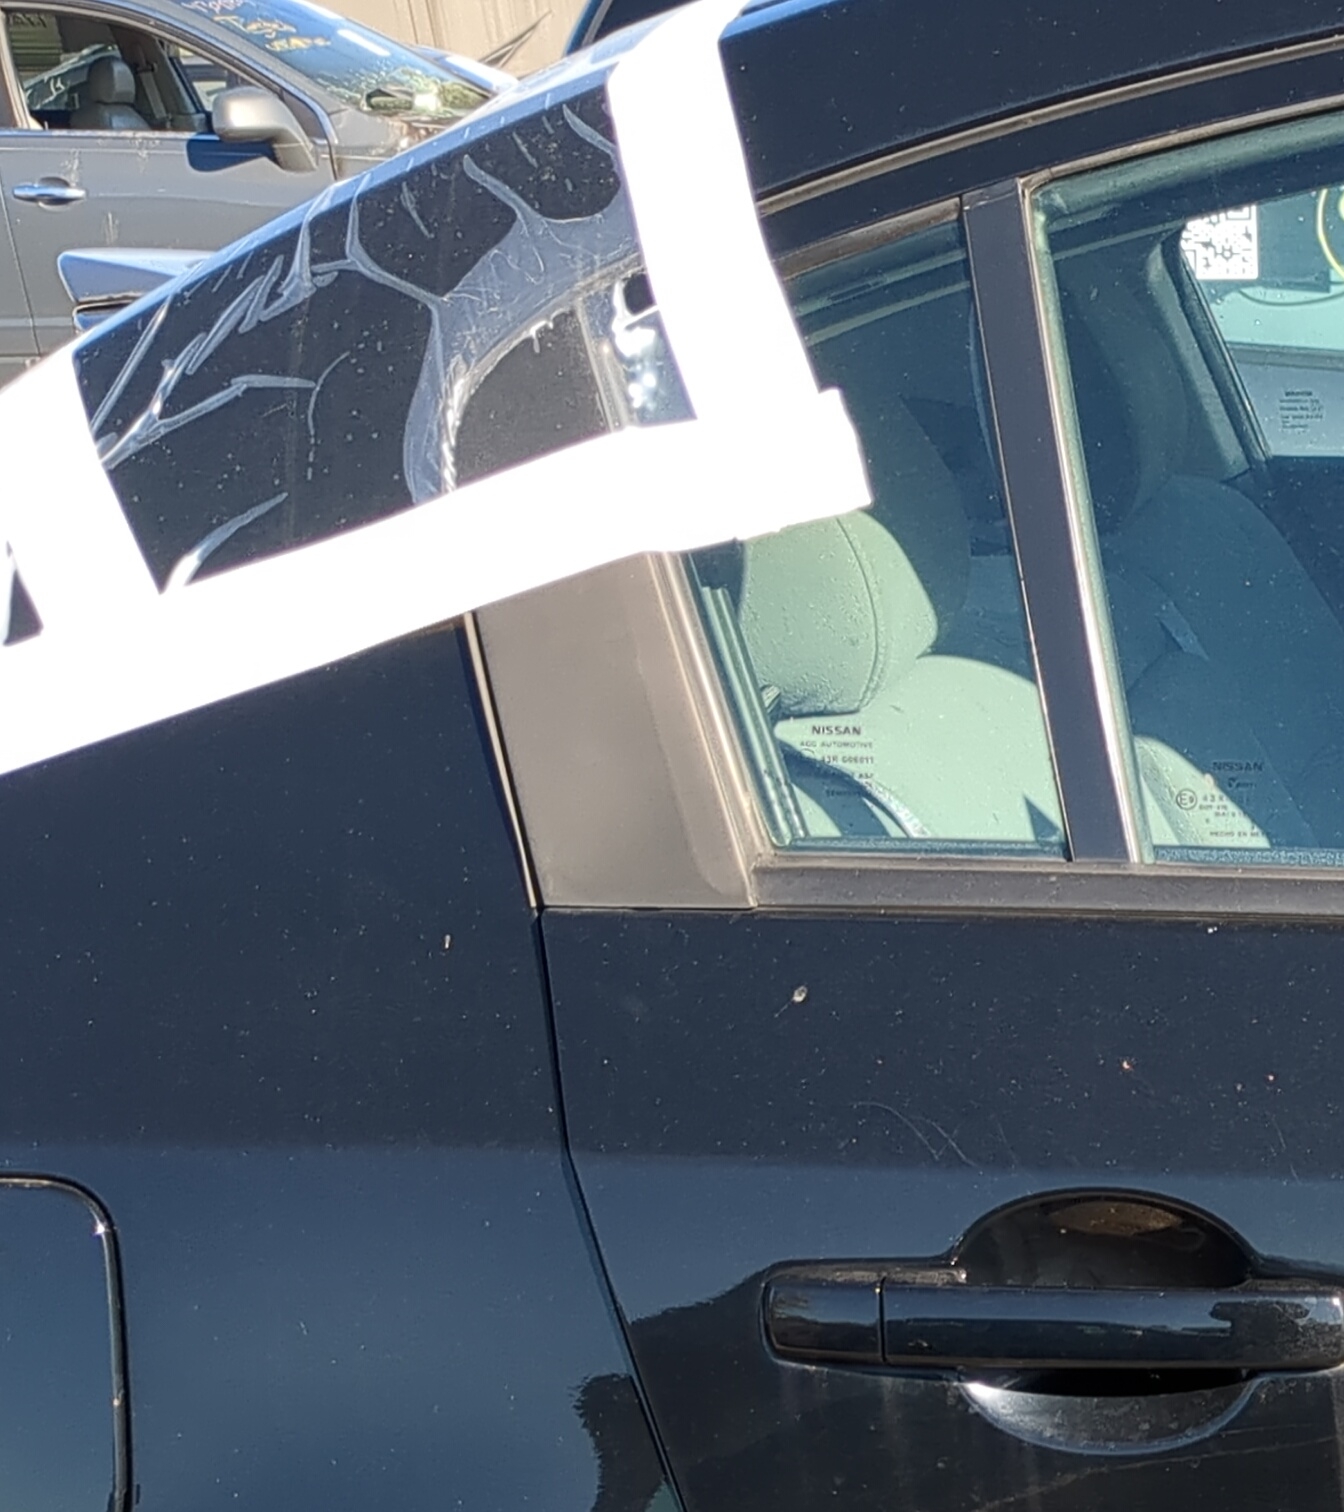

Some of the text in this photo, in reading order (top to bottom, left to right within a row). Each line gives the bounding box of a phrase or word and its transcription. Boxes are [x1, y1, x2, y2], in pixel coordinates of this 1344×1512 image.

[811, 725, 862, 736] NISSAN
[820, 741, 874, 749] AUTOMOTIVE
[1212, 761, 1264, 772] NISSAN
